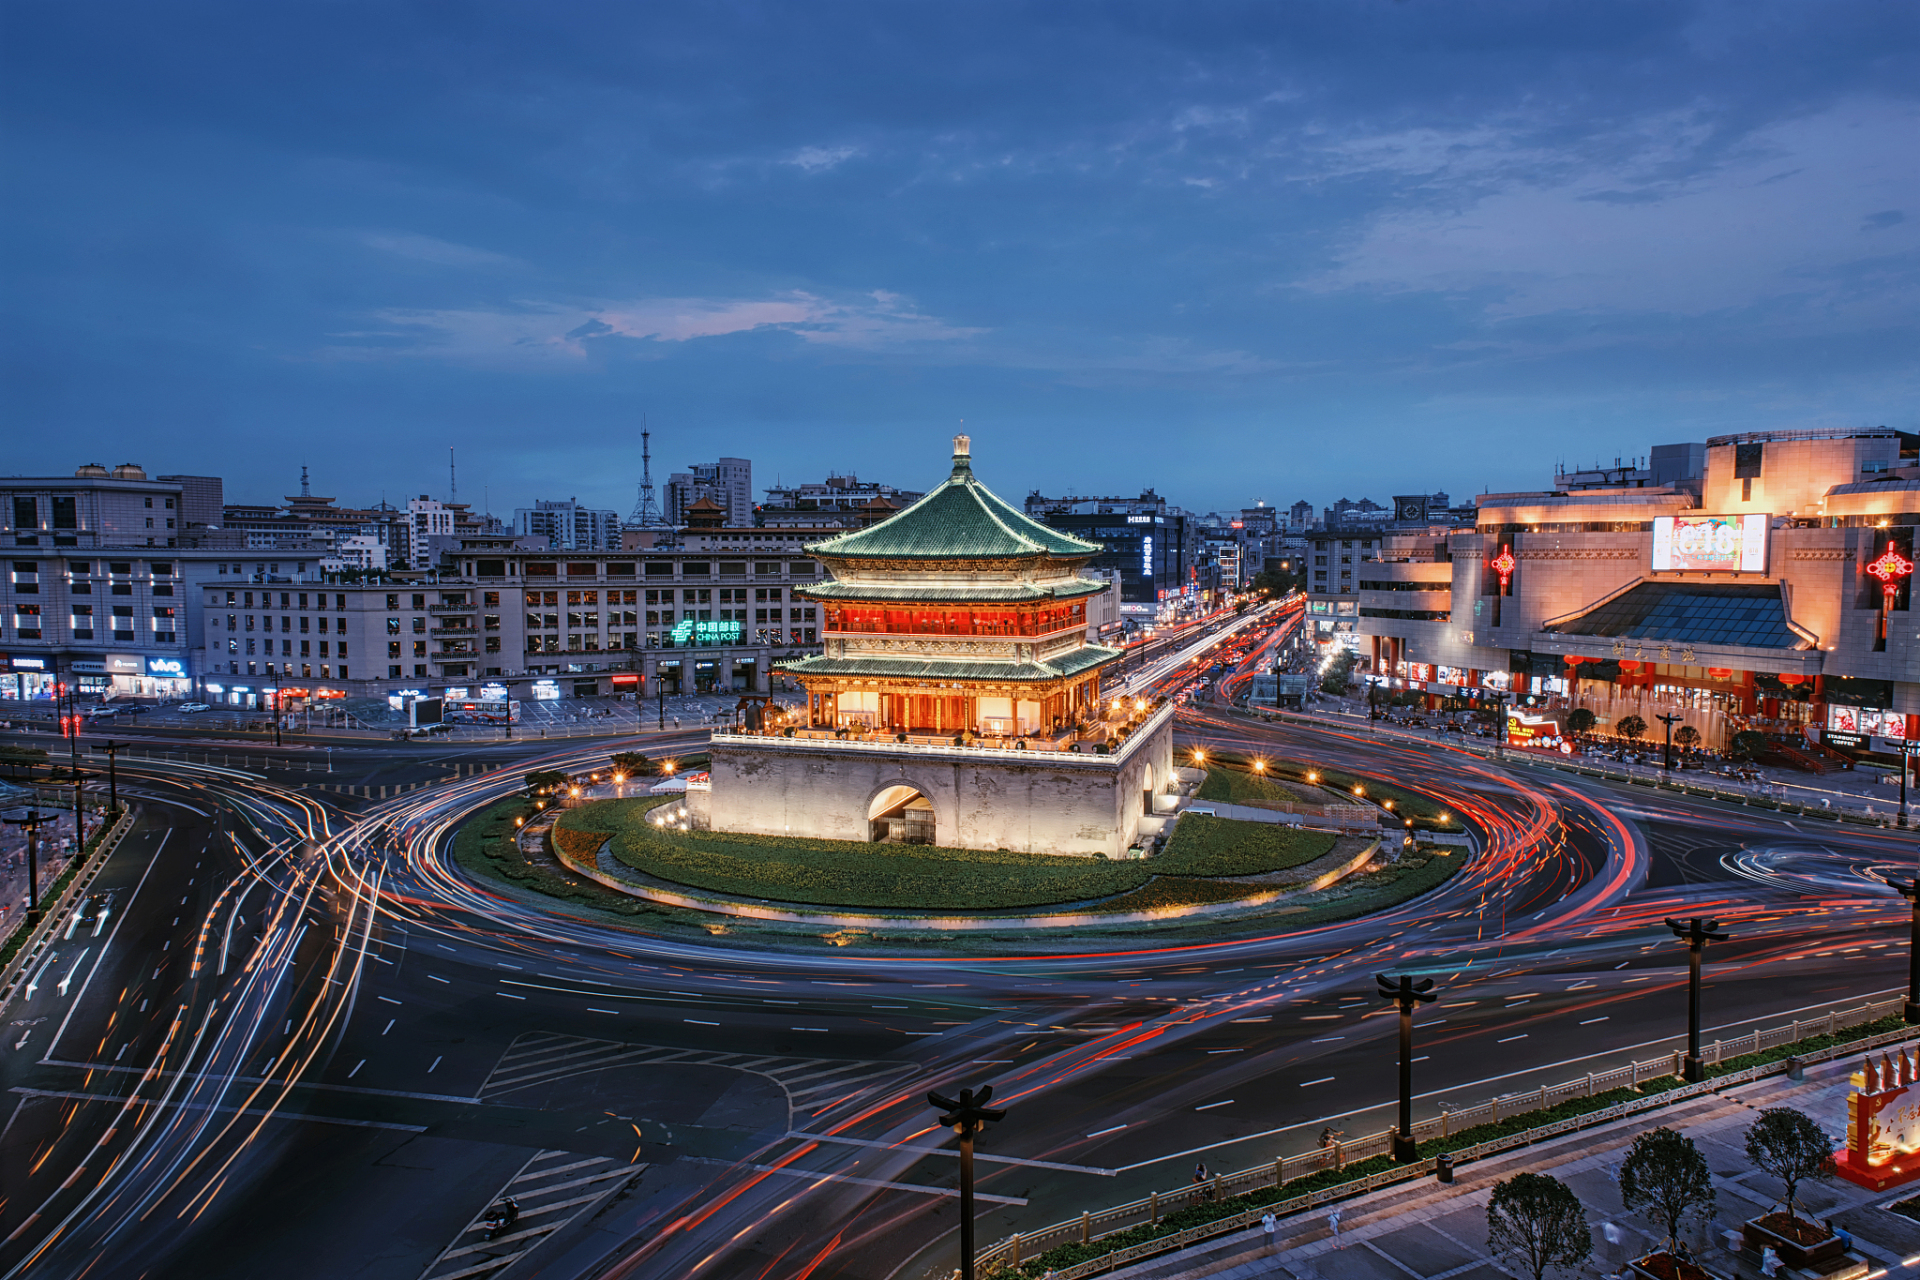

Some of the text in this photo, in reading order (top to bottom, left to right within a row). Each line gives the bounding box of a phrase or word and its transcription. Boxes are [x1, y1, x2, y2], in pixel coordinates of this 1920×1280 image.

[696, 621, 740, 633] 中国邮政
[696, 632, 740, 641] CHINA POST
[1826, 733, 1862, 743] STARBUCKS
[1832, 739, 1855, 747] COFFEE
[1897, 1101, 1920, 1123] 不忘
